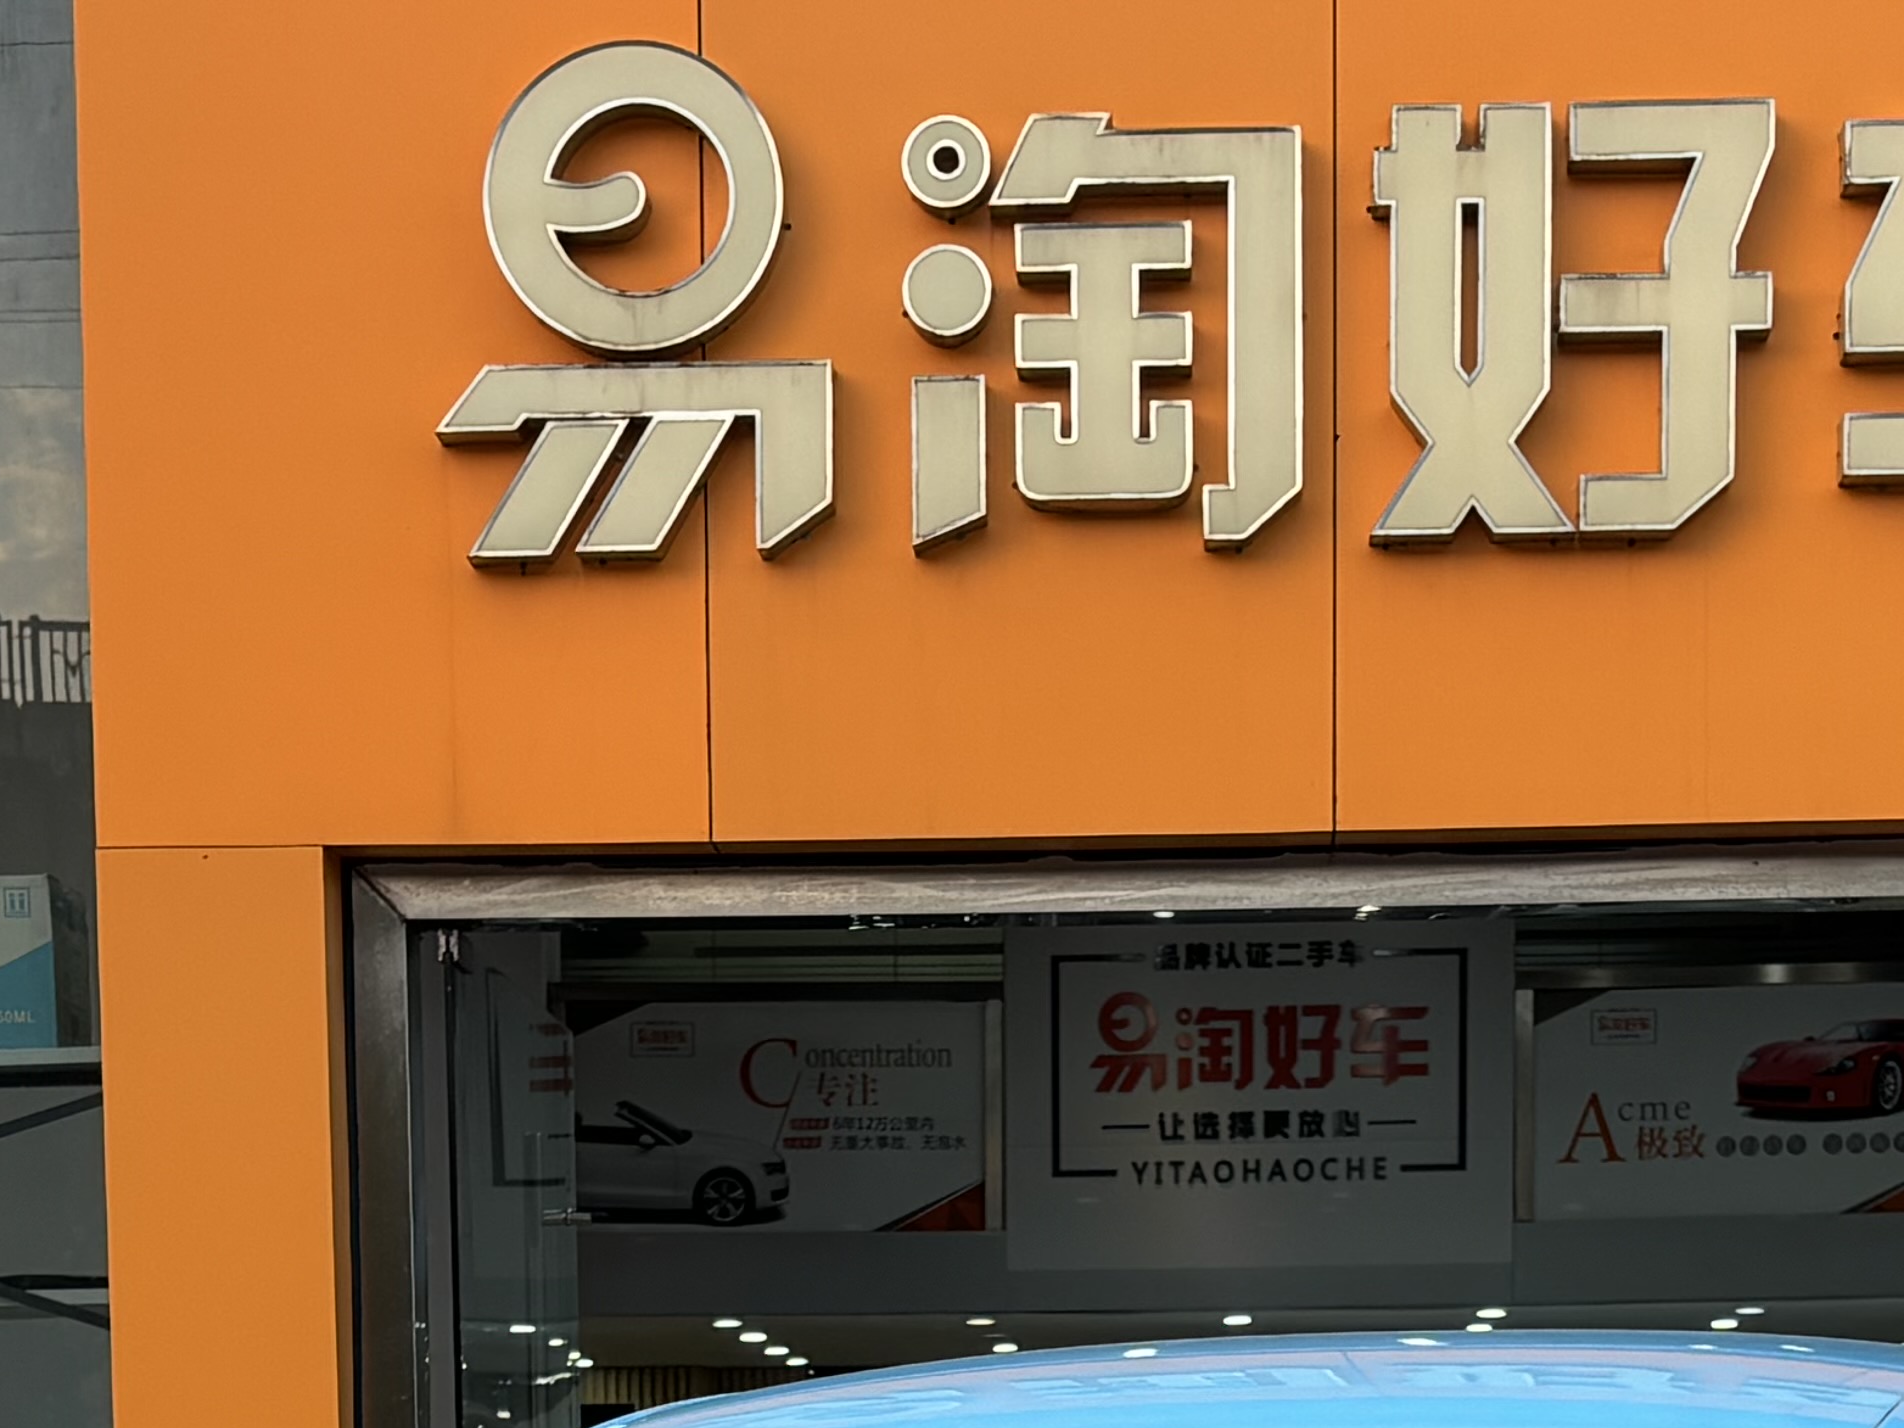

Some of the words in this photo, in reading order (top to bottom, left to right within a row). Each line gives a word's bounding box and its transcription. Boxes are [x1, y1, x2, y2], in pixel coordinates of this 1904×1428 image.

[1153, 940, 1365, 971] 品牌认证二手车
[1089, 990, 1431, 1094] 易淘好车
[739, 1037, 953, 1109] Concentration
[807, 1072, 879, 1107] 专注
[1557, 1091, 1692, 1164] Acme
[1636, 1124, 1707, 1161] 极致
[1130, 1157, 1389, 1187] YITAOHAOCHE
